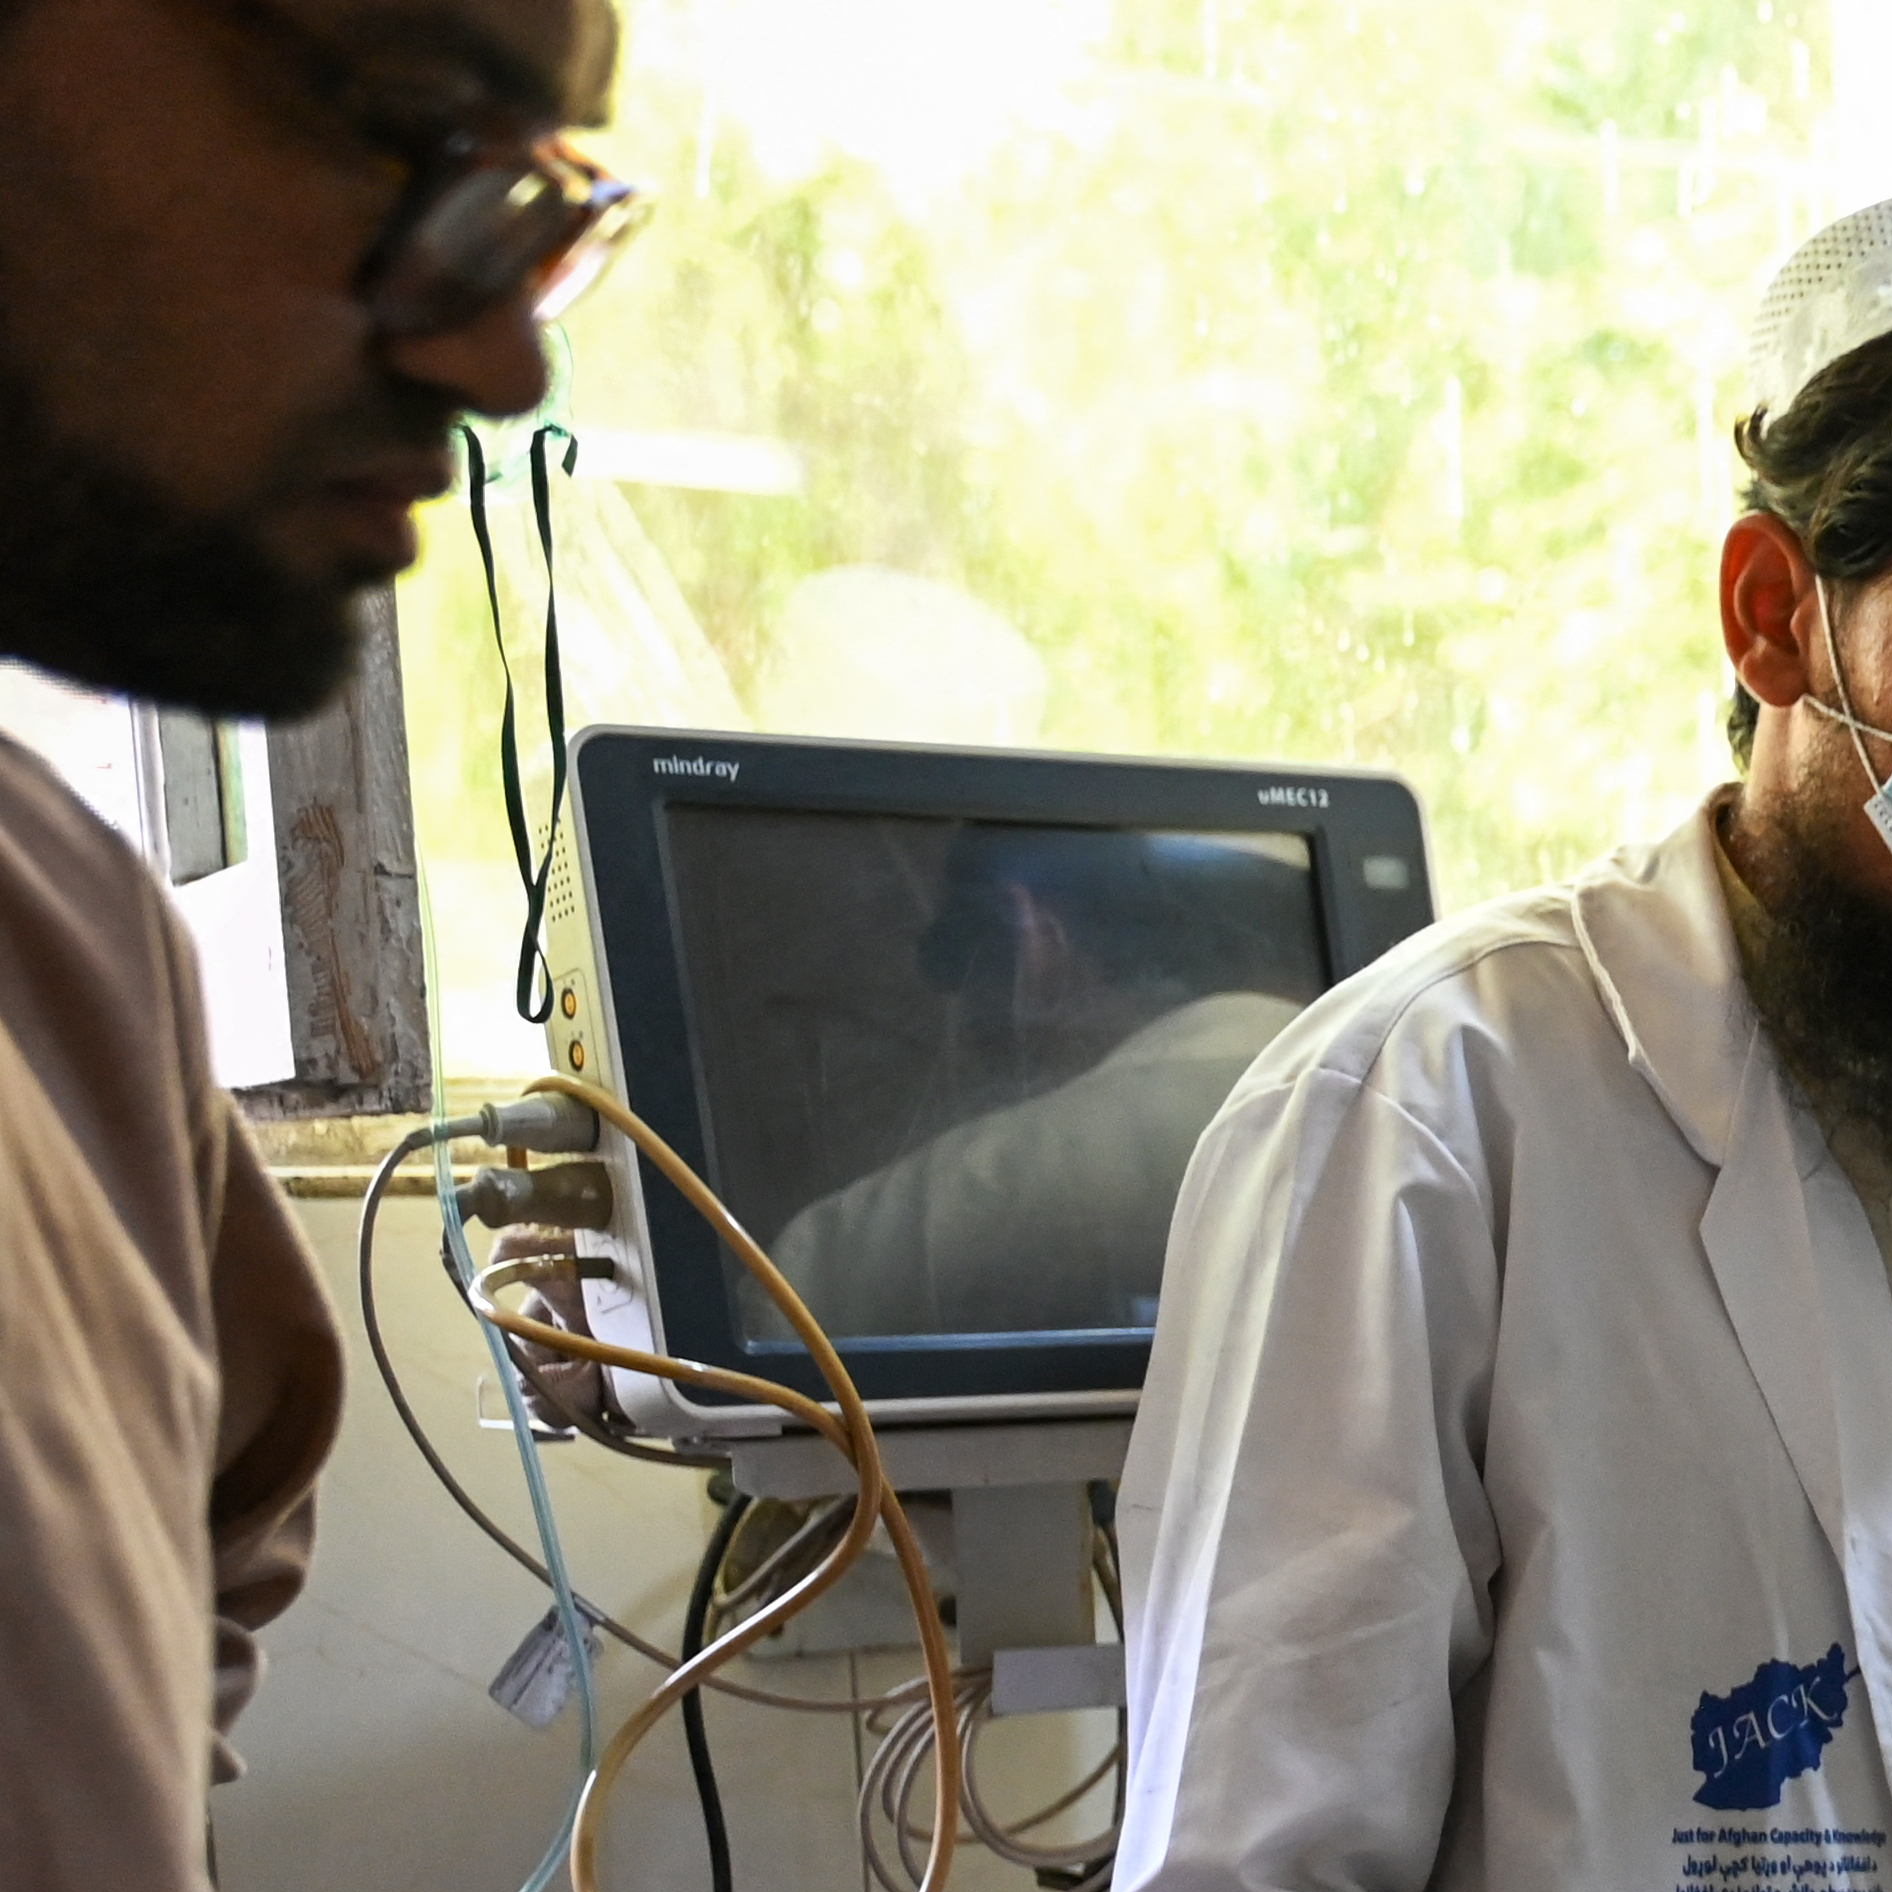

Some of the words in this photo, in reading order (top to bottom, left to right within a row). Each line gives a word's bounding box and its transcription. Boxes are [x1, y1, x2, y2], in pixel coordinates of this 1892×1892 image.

[653, 754, 740, 783] mindray
[1708, 1676, 1838, 1778] JACK
[1672, 1827, 1694, 1844] Just
[1696, 1827, 1715, 1844] for
[1717, 1827, 1767, 1848] Afghan
[1770, 1827, 1822, 1848] Capacity
